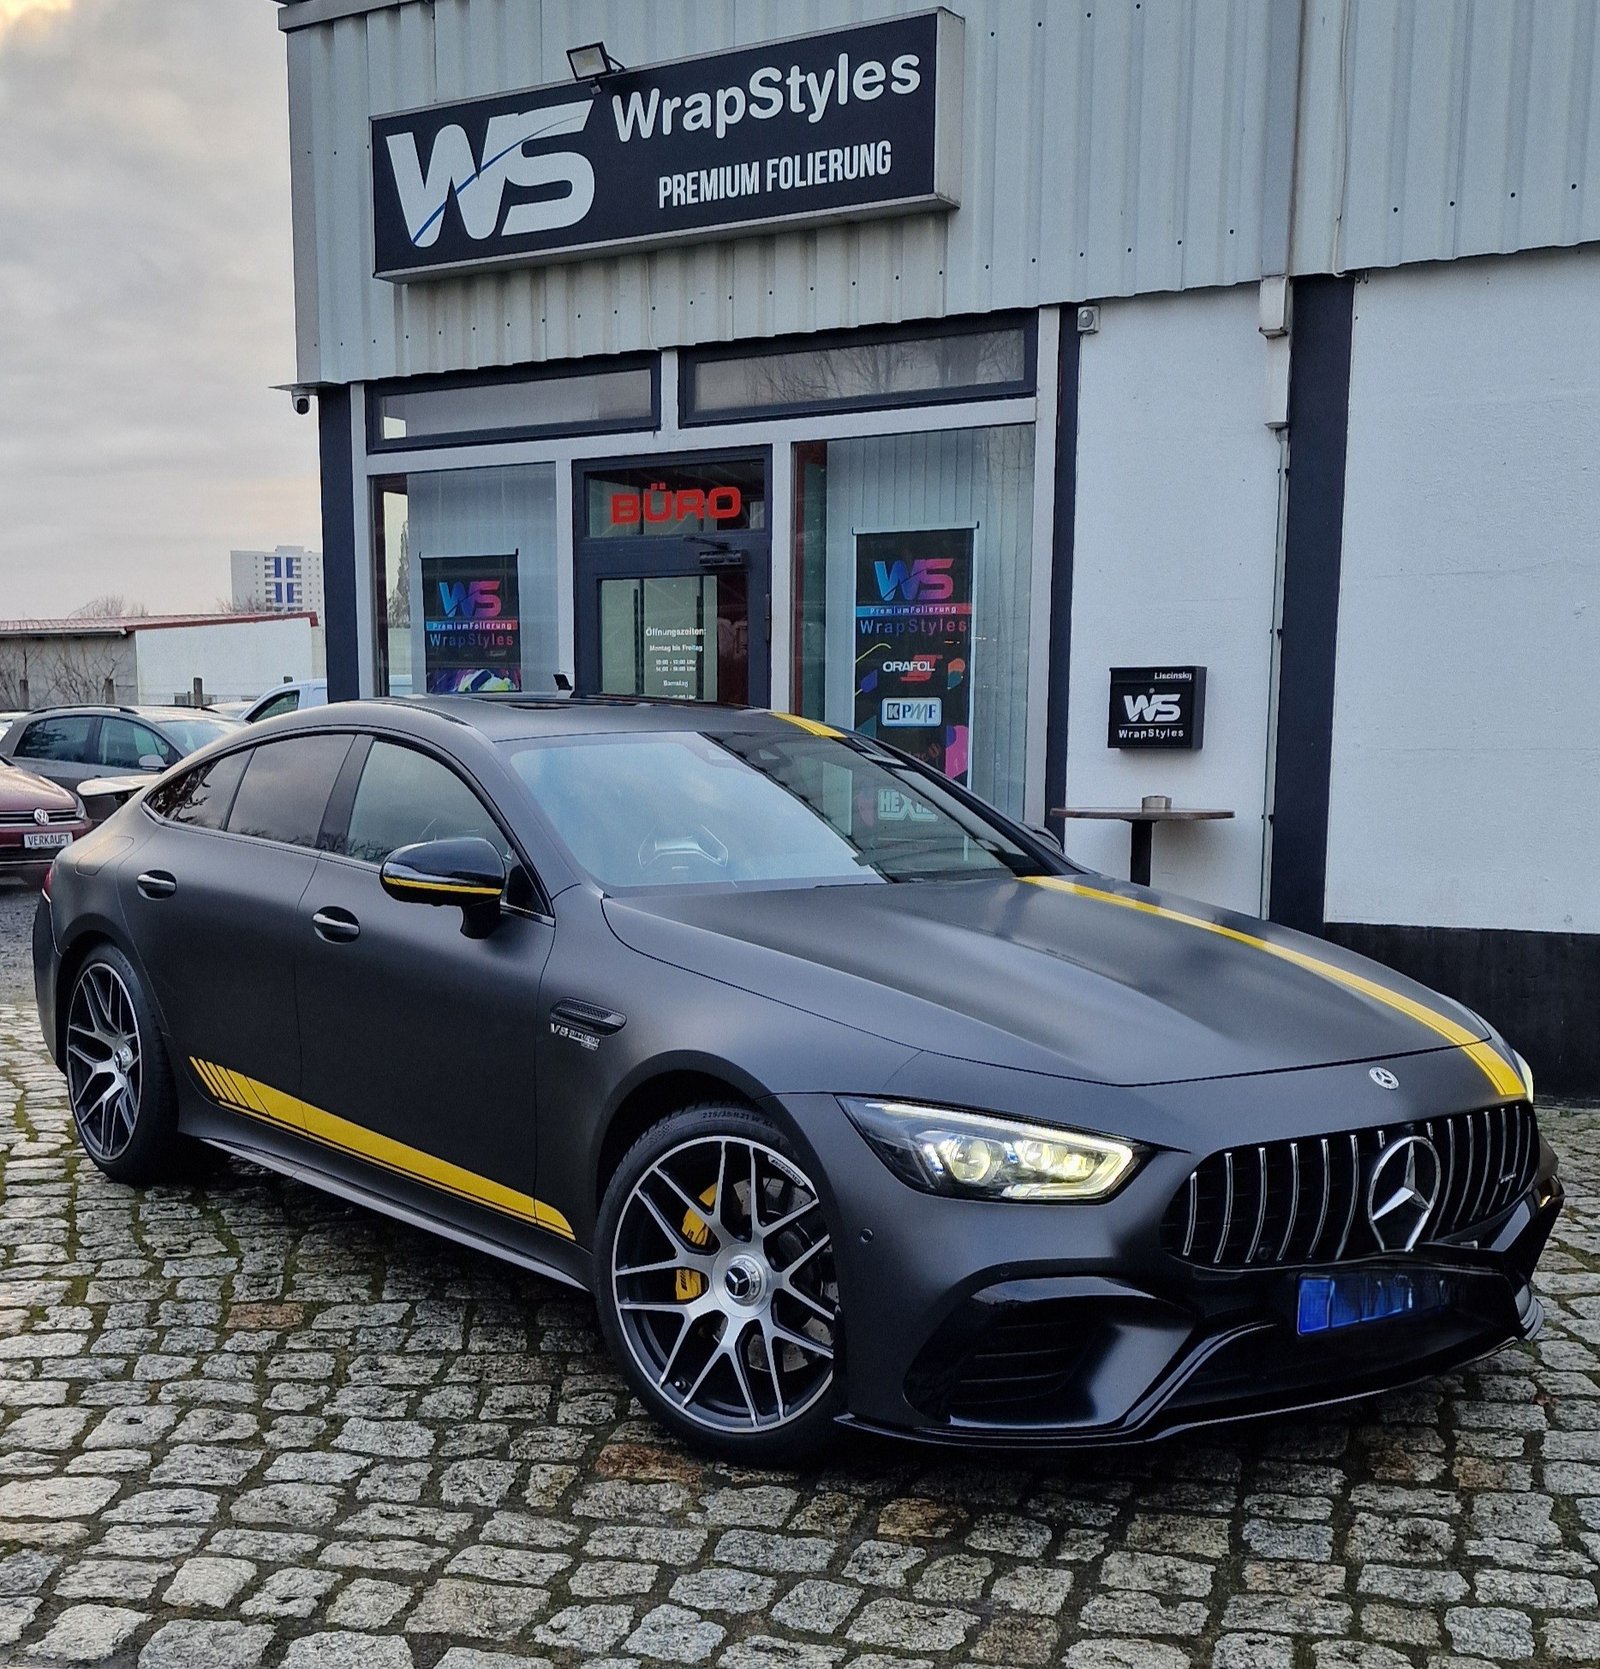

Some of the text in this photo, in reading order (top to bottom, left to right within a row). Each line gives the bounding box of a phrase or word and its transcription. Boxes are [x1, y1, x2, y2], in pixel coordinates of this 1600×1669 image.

[611, 53, 921, 143] WrapStyles
[385, 99, 595, 248] WS
[658, 140, 892, 209] PREMIUM FOLIERUNG
[611, 482, 741, 525] BÜRO
[874, 558, 954, 602] WS
[438, 580, 502, 618] WS
[860, 618, 967, 636] WrapStyles
[430, 632, 514, 649] WrapStyles
[882, 660, 936, 672] ORAFOL
[886, 702, 937, 723] KPMF
[1123, 693, 1182, 722] WS
[1118, 728, 1185, 740] WrapStyles
[27, 834, 70, 846] VERKAUFT
[550, 1022, 569, 1038] V8
